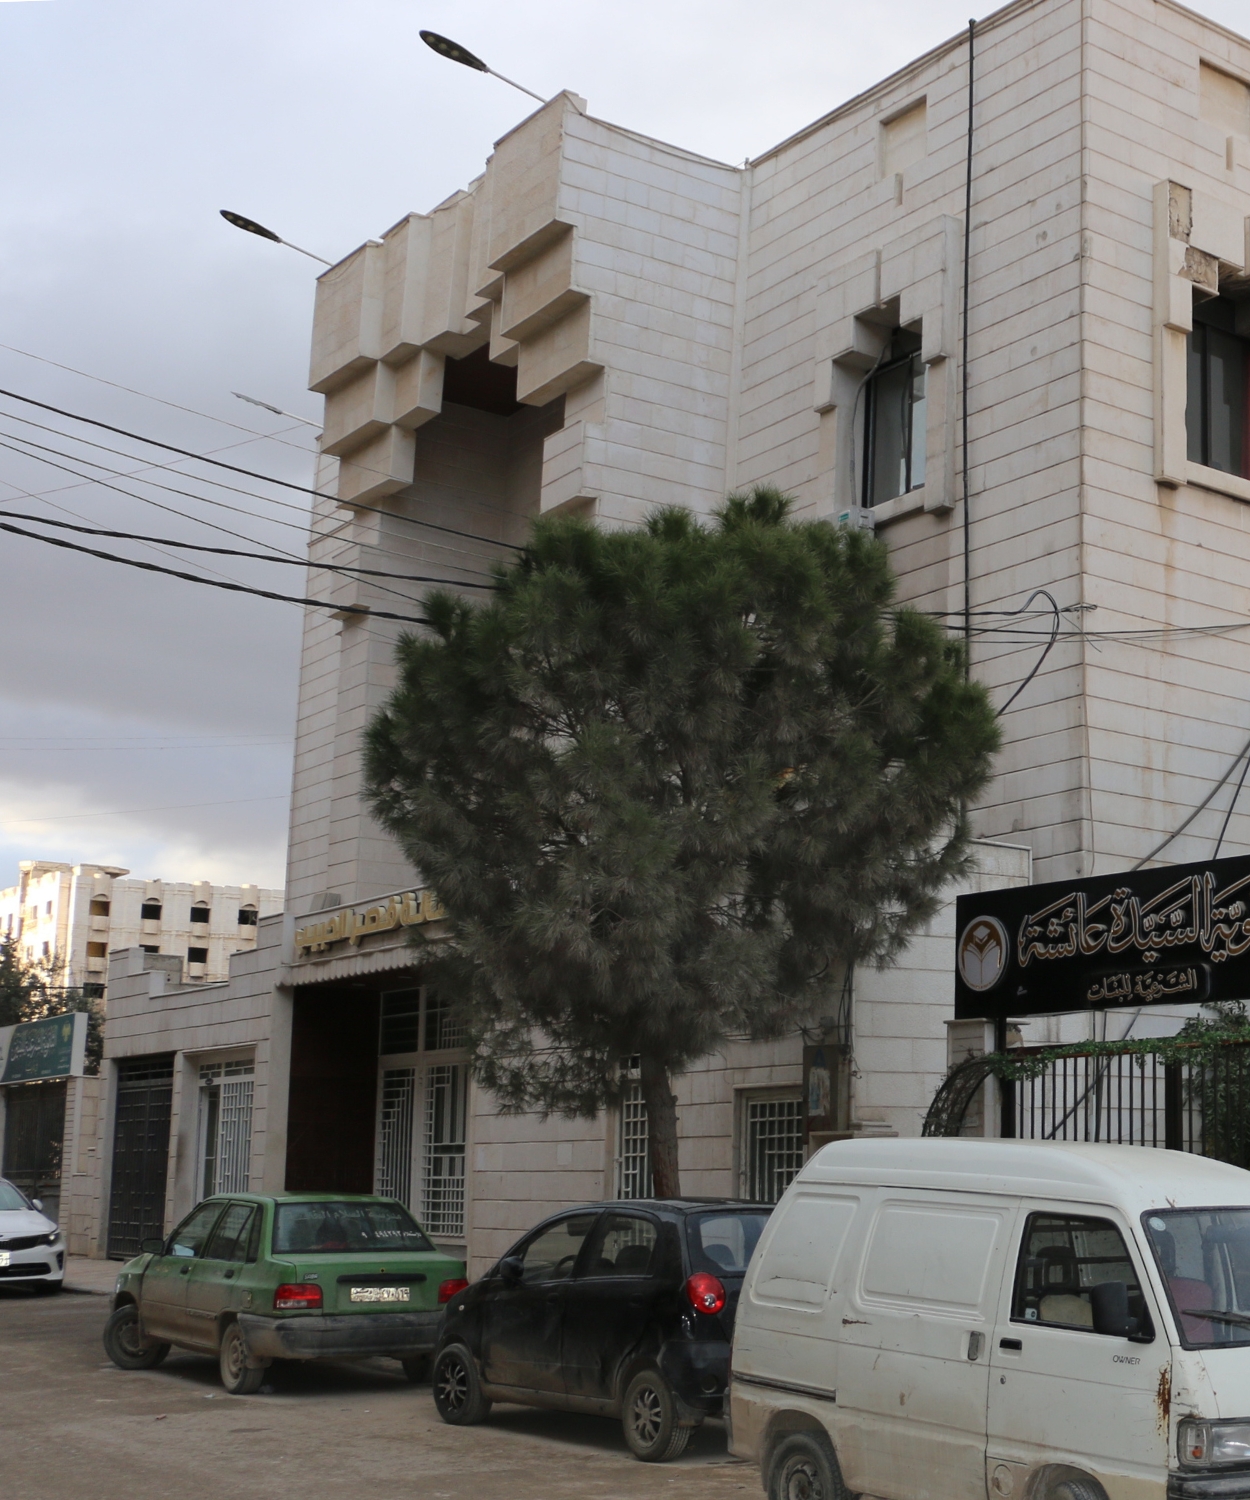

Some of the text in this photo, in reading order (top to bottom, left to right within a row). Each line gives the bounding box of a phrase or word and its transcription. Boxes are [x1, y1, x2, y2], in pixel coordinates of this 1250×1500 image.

[1017, 892, 1114, 968] عائشة
[1109, 871, 1213, 964] السيدة
[1086, 967, 1198, 1003] الشرعية للبنات
[1112, 1354, 1141, 1365] OWNER
